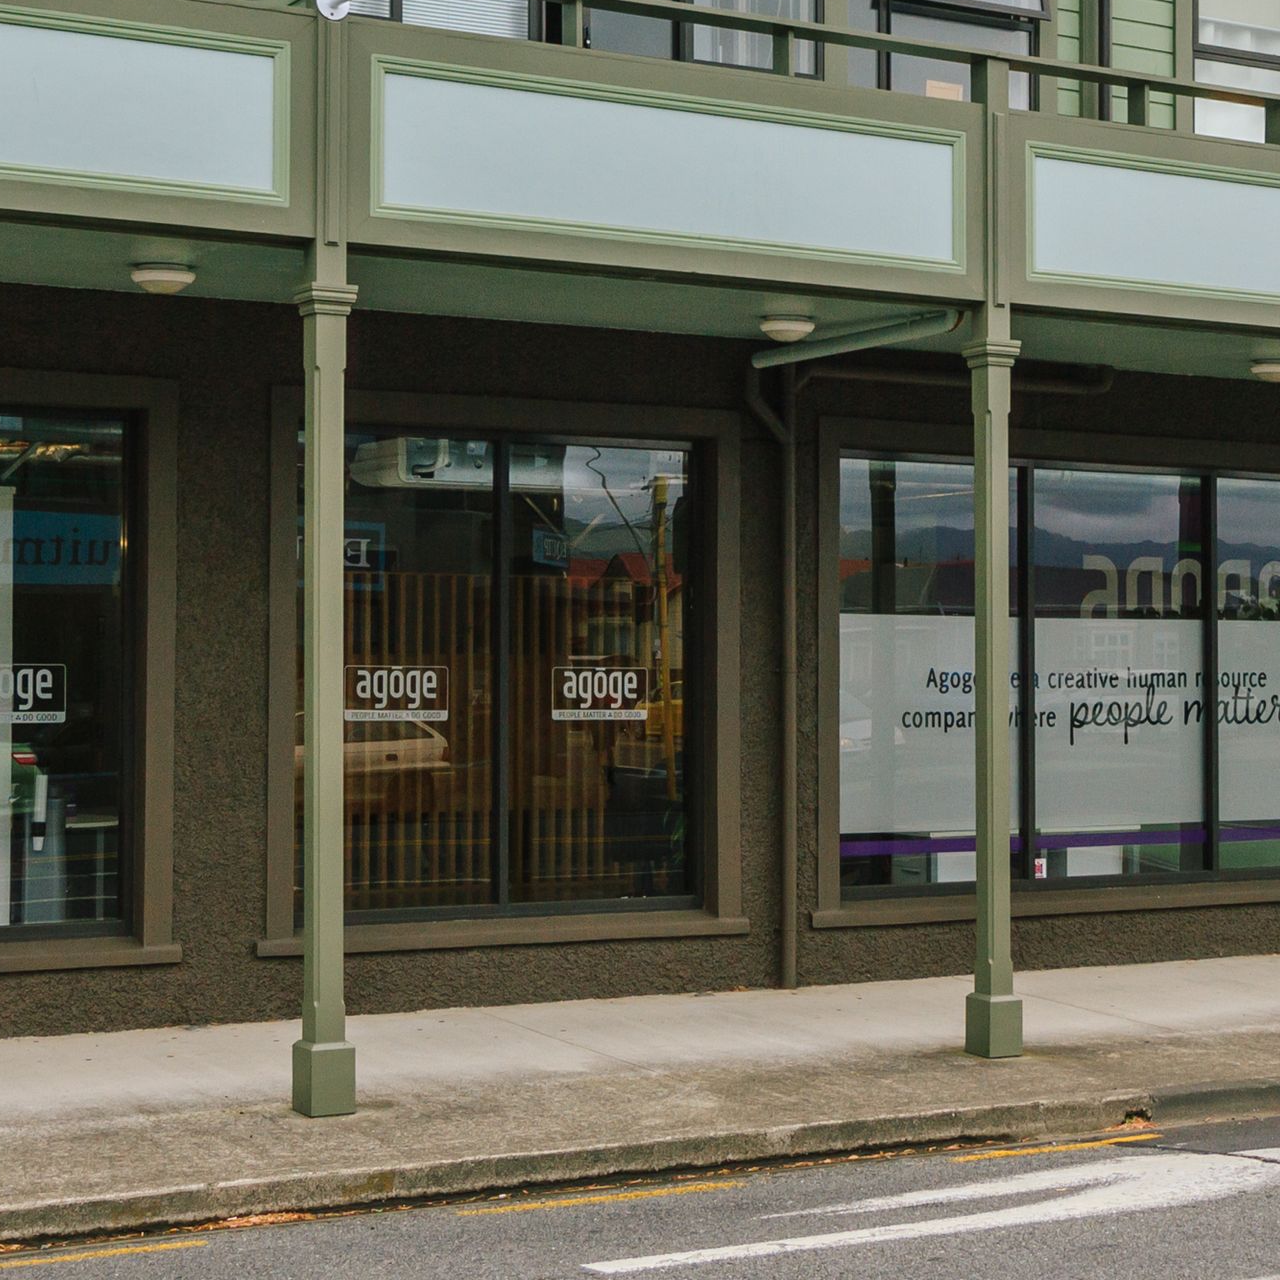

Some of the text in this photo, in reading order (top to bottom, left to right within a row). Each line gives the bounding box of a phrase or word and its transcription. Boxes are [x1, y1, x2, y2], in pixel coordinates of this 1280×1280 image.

[926, 668, 976, 694] Agog
[1048, 667, 1119, 689] creative
[1127, 667, 1187, 689] human
[23, 713, 34, 721] DO
[36, 713, 58, 721] GOOD
[902, 710, 976, 733] compan
[1070, 682, 1173, 745] people
